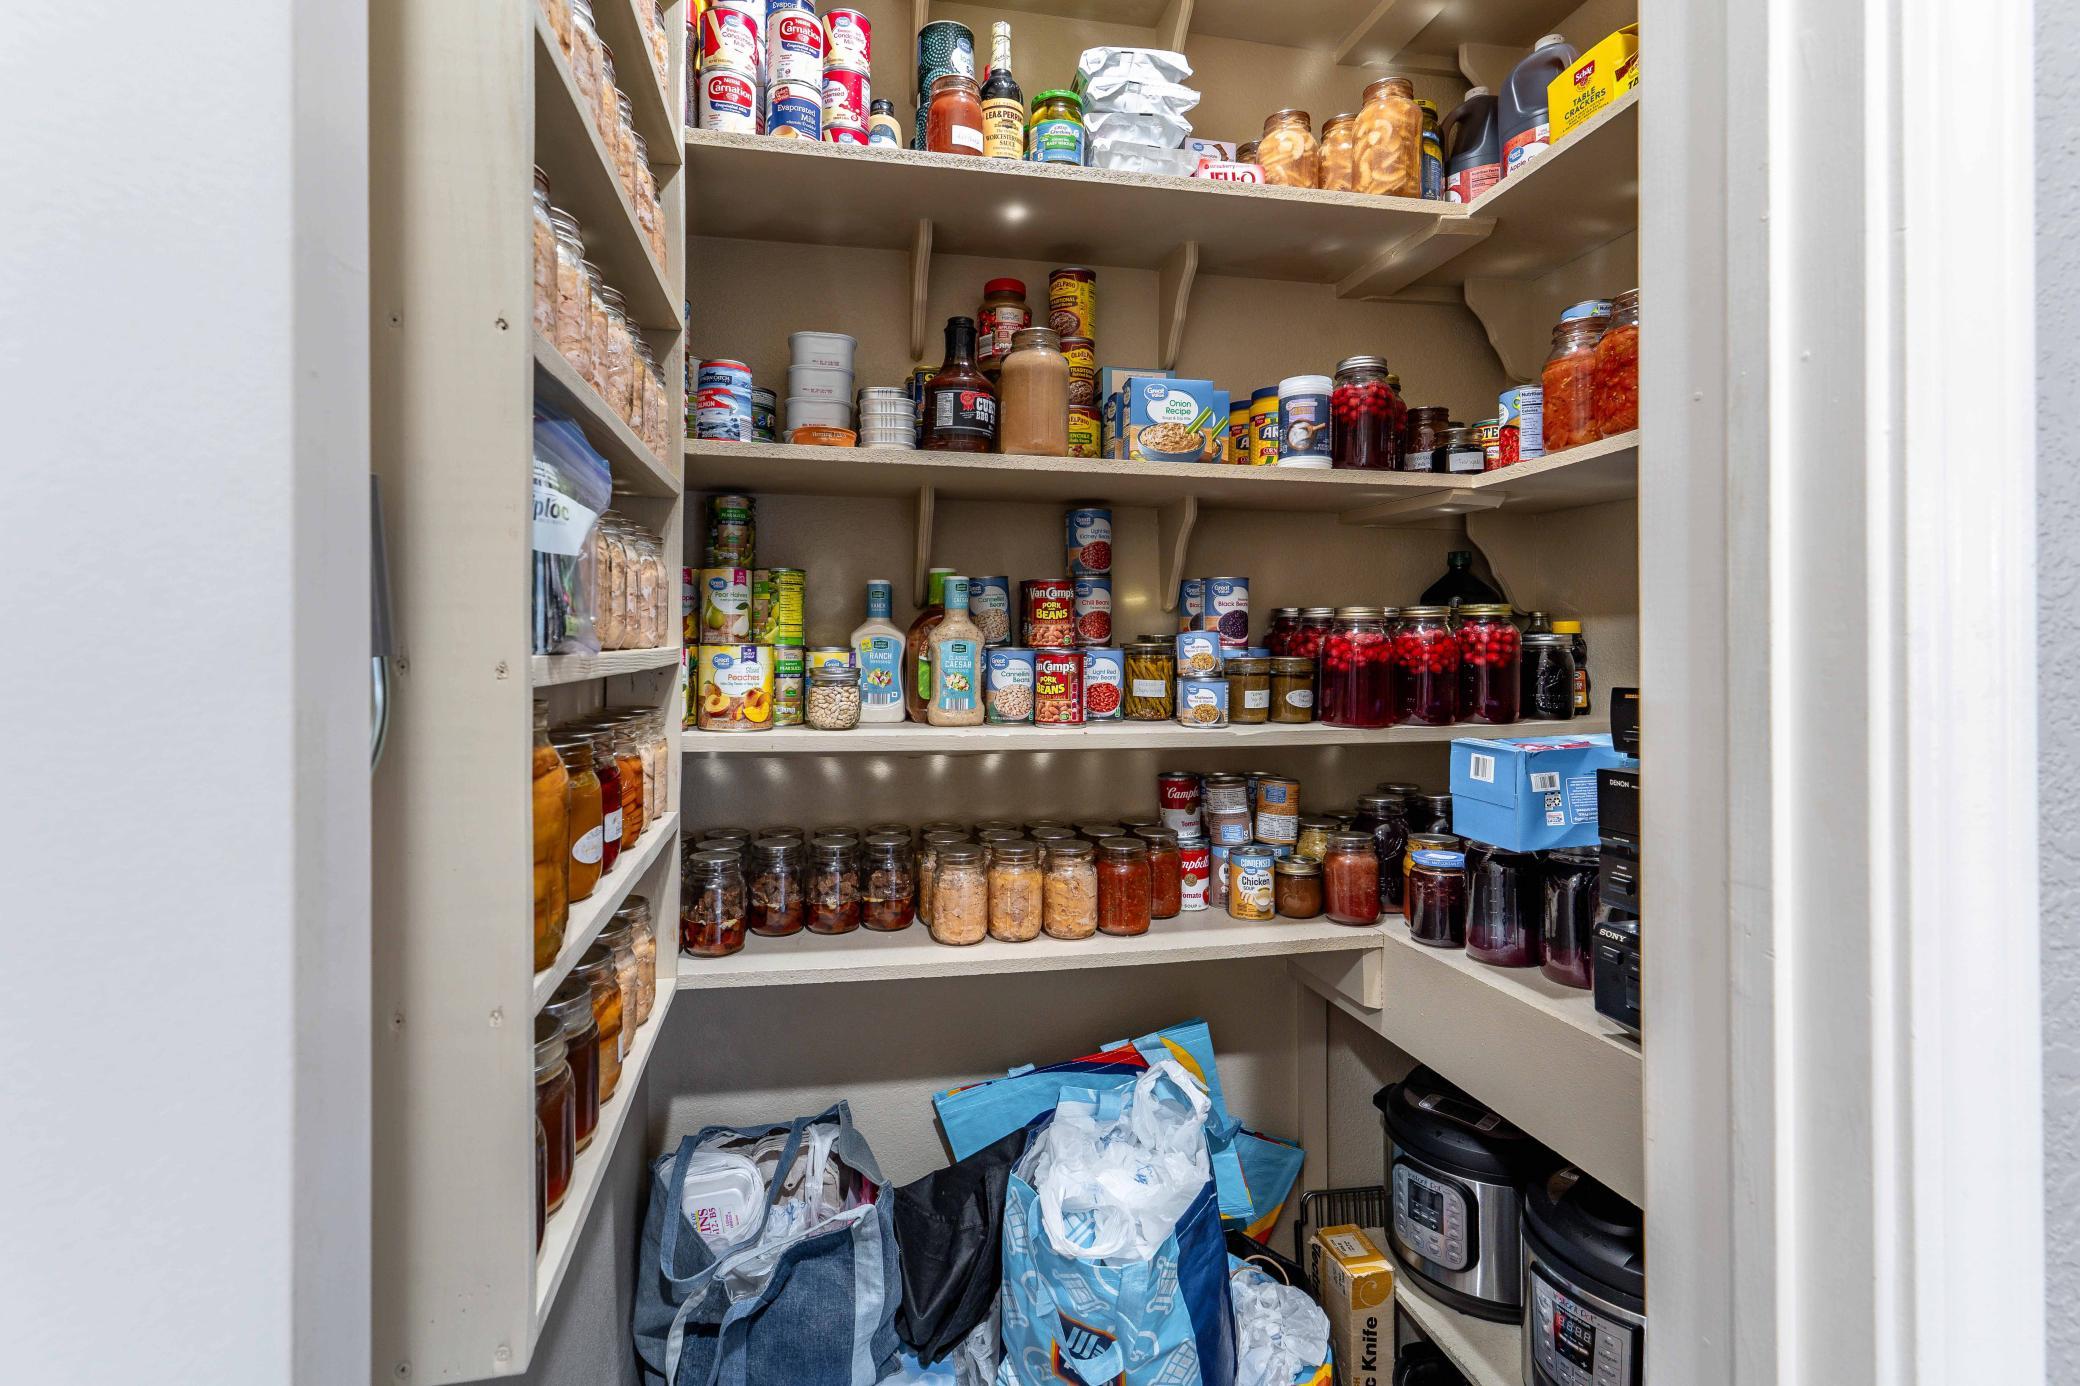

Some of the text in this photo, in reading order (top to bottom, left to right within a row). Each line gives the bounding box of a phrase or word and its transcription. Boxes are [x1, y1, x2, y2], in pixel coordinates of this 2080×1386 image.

[781, 20, 822, 43] Carnation
[710, 79, 752, 101] Carnation
[1573, 86, 1596, 106] TABLE
[1564, 88, 1608, 121] CRACKERS
[777, 104, 816, 117] Evaporated
[801, 113, 816, 126] Milk
[1509, 160, 1531, 174] Apple
[1147, 386, 1165, 394] Great
[1169, 399, 1192, 408] Onion
[1165, 407, 1192, 417] Recipe
[714, 591, 729, 599] Pear
[1030, 586, 1074, 601] Van Camp's
[1042, 601, 1061, 609] PORK
[1036, 609, 1068, 620] BEANS
[869, 652, 893, 660] RANCH
[945, 660, 972, 669] CAESAR
[1043, 660, 1075, 675] Camp's
[727, 673, 760, 681] Peaches
[1040, 675, 1057, 684] PORK
[1037, 683, 1066, 695] BEANS
[1609, 778, 1630, 789] DENON
[1240, 858, 1271, 868] CONDENSED
[1241, 876, 1271, 887] Chicken
[1599, 928, 1627, 943] SONY
[1361, 1316, 1378, 1371] Knife
